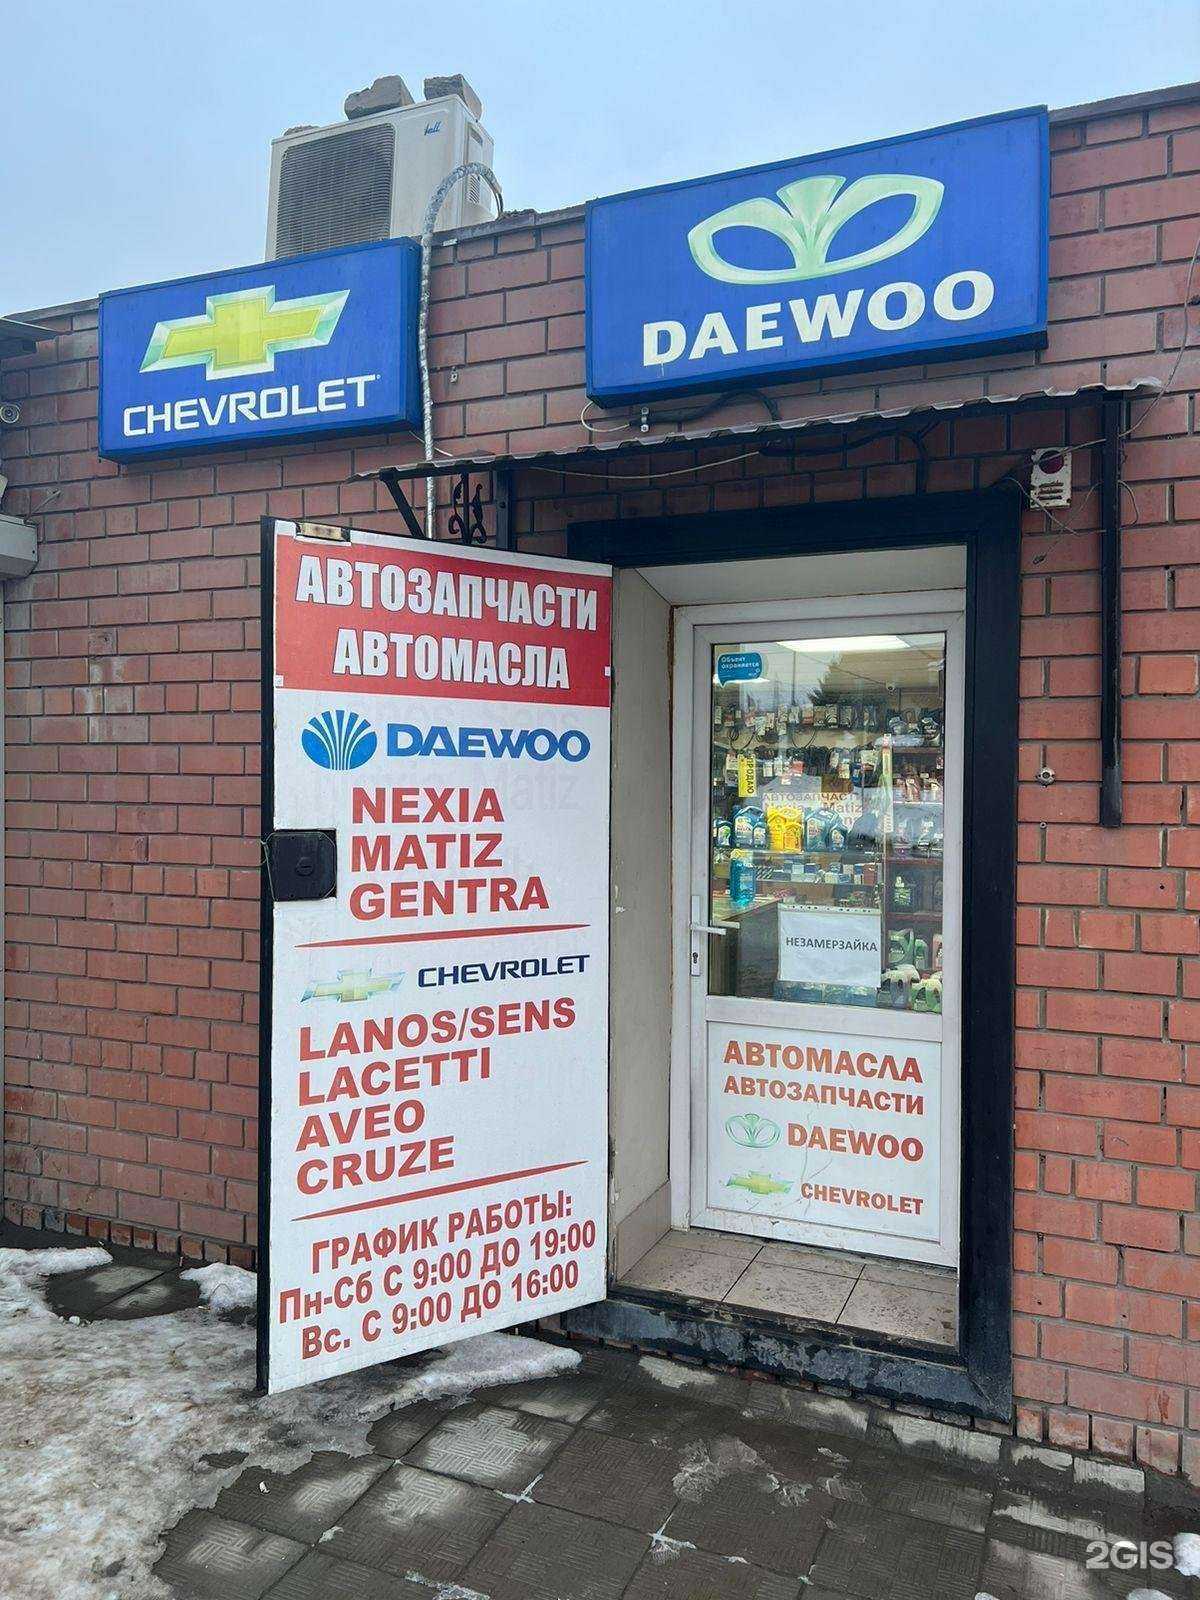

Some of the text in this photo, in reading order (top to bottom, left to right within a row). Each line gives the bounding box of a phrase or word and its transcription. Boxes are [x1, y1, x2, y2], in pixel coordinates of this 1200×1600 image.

[643, 270, 995, 368] DAEWOO
[123, 373, 377, 438] CHEVROLET
[296, 555, 598, 631] АВТОЗАПЧАСТИ
[332, 628, 570, 689] АВТОМАСЛА
[387, 723, 591, 762] DAEWOO
[352, 787, 504, 823] NEXIA
[351, 833, 503, 872] MATIZ
[350, 876, 550, 921] GENTRA
[418, 954, 590, 988] CHEVROLET
[786, 936, 878, 953] НЕЗАМЕРЗАЙКА
[300, 997, 576, 1061] LANOS/SENS
[299, 1047, 490, 1106] LACETTI
[723, 1040, 923, 1083] АВТОМАСЛА
[723, 1076, 923, 1115] АВТОЗАПЧАСТИ
[296, 1099, 425, 1152] AVEO
[787, 1122, 924, 1162] DAEWOO
[297, 1136, 454, 1195] CRUZE
[800, 1182, 923, 1215] CHEVROLET
[312, 1190, 572, 1274] ГРАФИК РАБОТЫ:
[279, 1220, 596, 1323] Пн-Сб С 9:00 ДО 19:00
[302, 1260, 579, 1360] Вс. С 9:00 ДО 16:00
